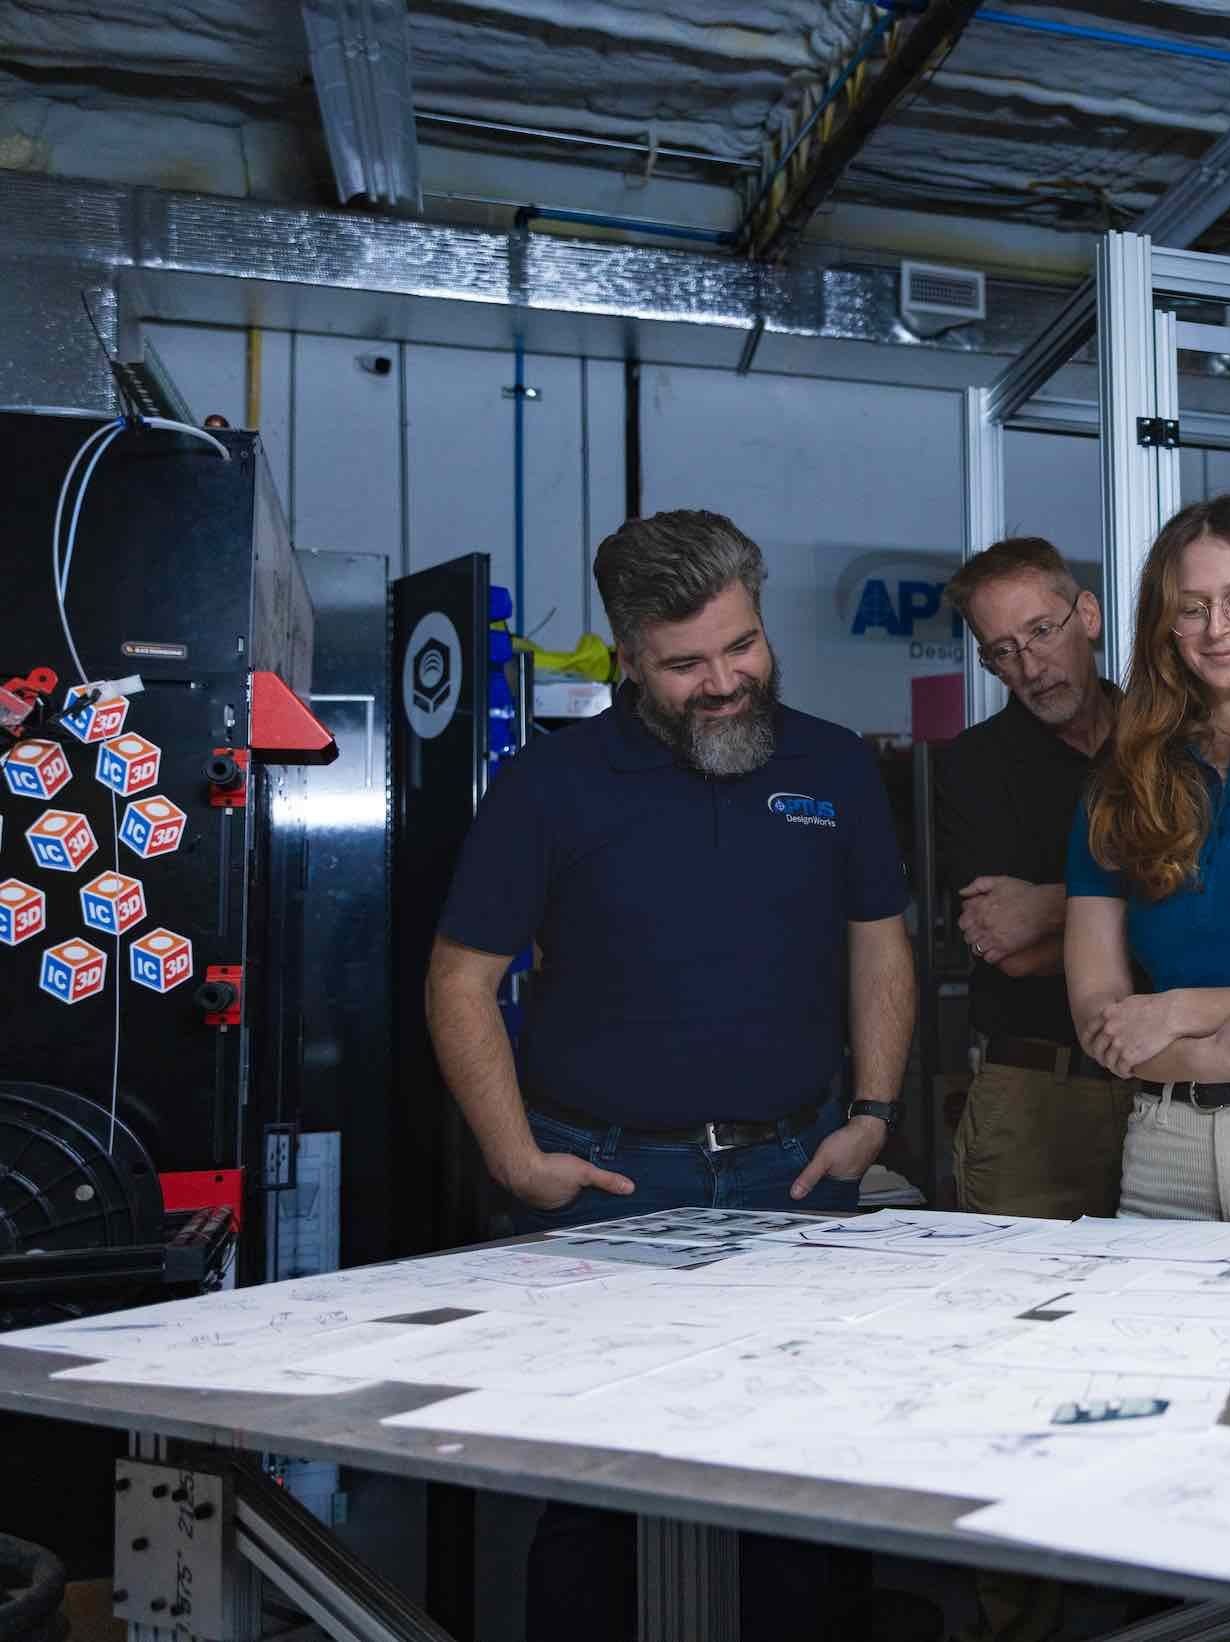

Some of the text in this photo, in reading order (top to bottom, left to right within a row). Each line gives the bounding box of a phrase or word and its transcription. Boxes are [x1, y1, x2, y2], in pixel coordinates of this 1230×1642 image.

[93, 711, 122, 733] 3D
[11, 756, 65, 790] IC 3D
[103, 754, 155, 785] IC 3D
[127, 818, 180, 848] IC 3D
[786, 813, 837, 829] DesignWorks
[37, 828, 91, 863] IC 3D
[16, 905, 41, 932] 3D
[88, 893, 142, 924] IC 3D
[47, 965, 101, 992] IC 3D
[137, 952, 189, 981] IC 3D
